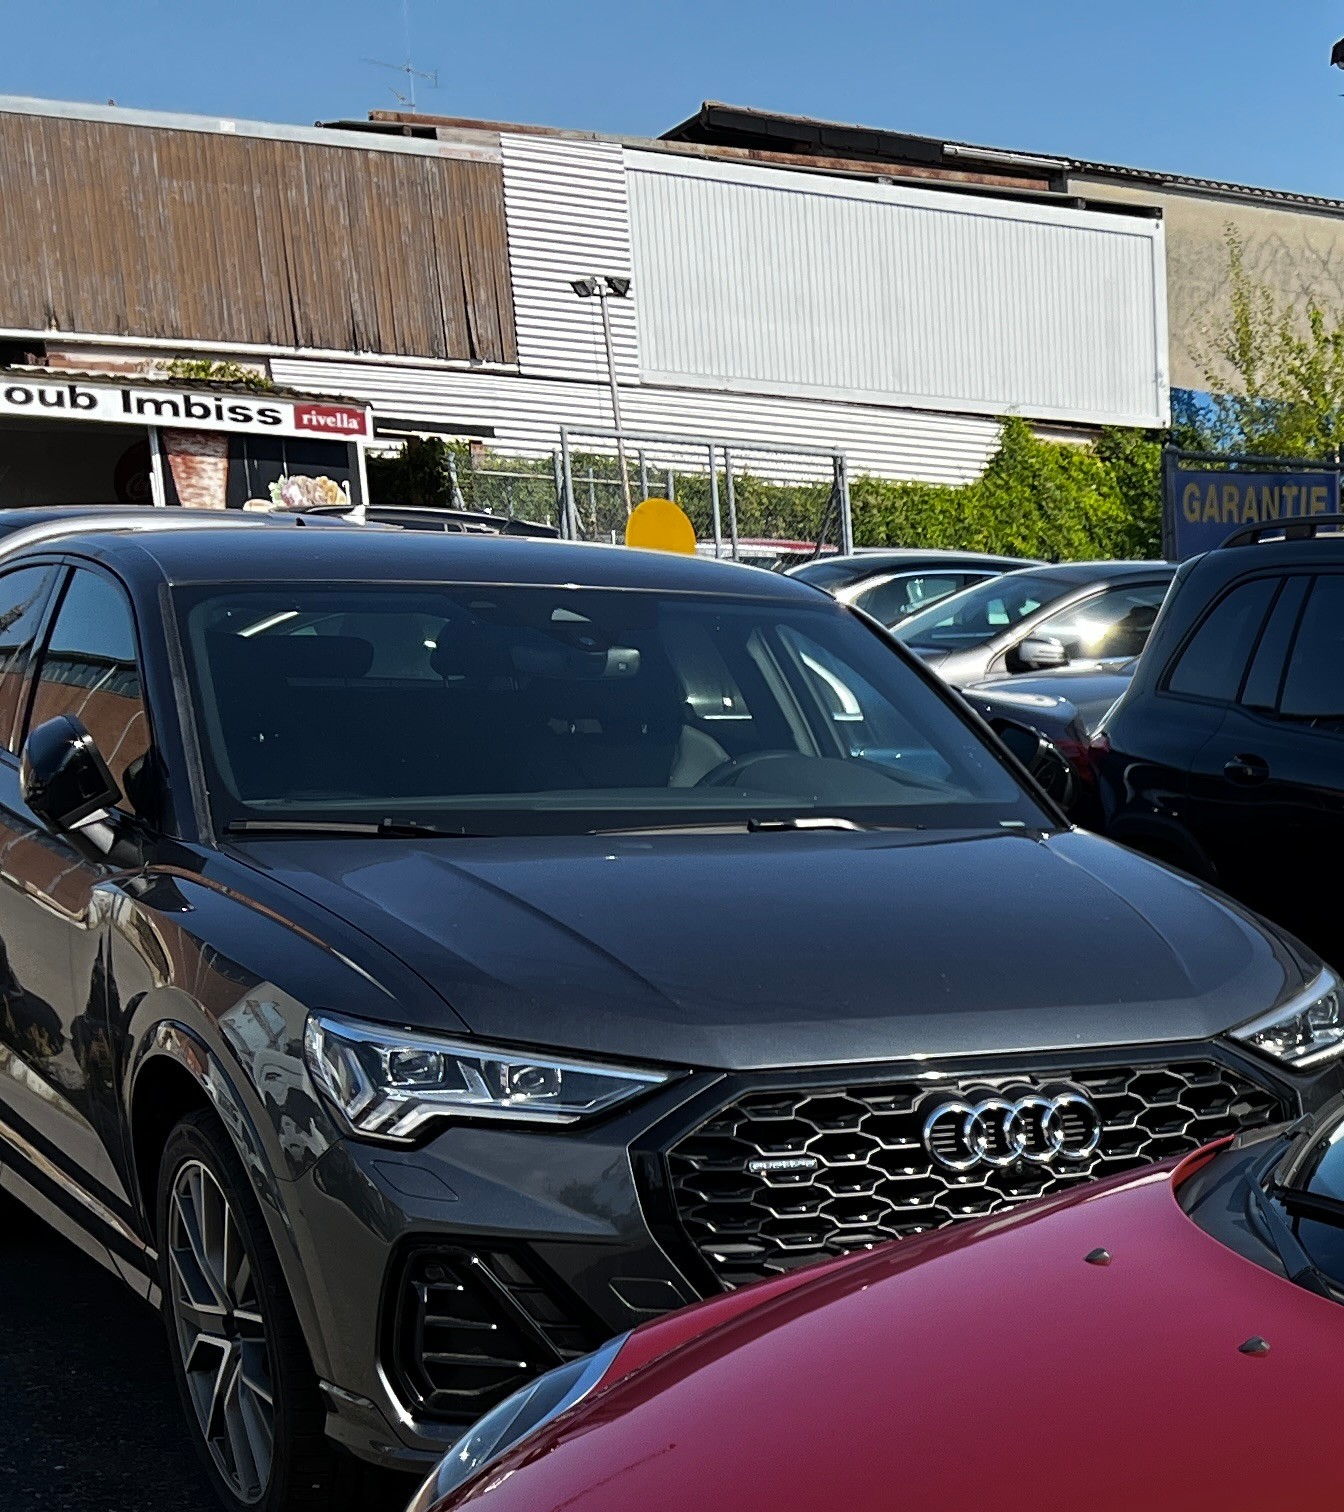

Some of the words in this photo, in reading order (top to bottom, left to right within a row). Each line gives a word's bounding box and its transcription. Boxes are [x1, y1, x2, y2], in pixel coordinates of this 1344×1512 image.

[4, 384, 98, 411] oub
[122, 388, 283, 426] Imbiss
[302, 409, 359, 430] rivella
[1182, 482, 1328, 523] GARANTIE
